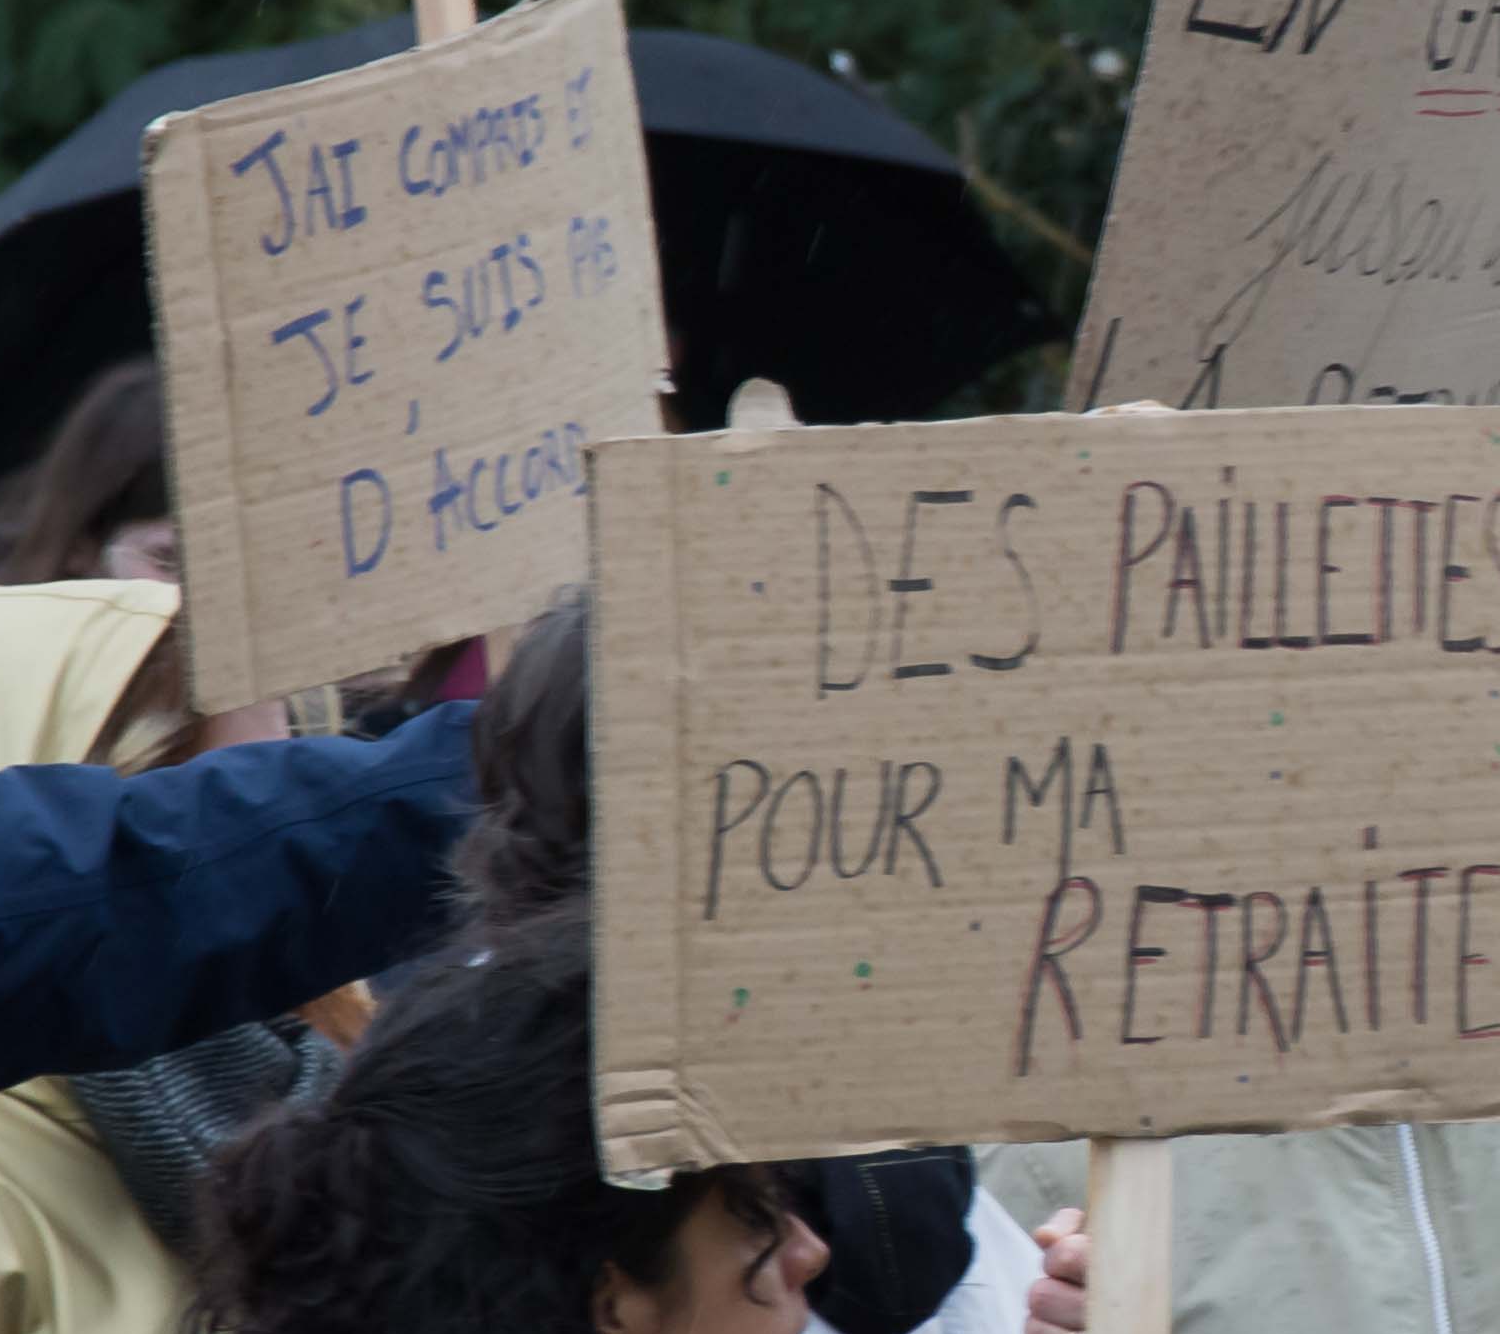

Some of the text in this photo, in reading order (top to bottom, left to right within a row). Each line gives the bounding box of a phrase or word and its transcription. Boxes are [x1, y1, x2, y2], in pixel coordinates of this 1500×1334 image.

[271, 294, 376, 416] JE
[421, 233, 547, 363] SUIS
[811, 483, 1041, 698] DES
[703, 736, 1125, 919] POUR MA
